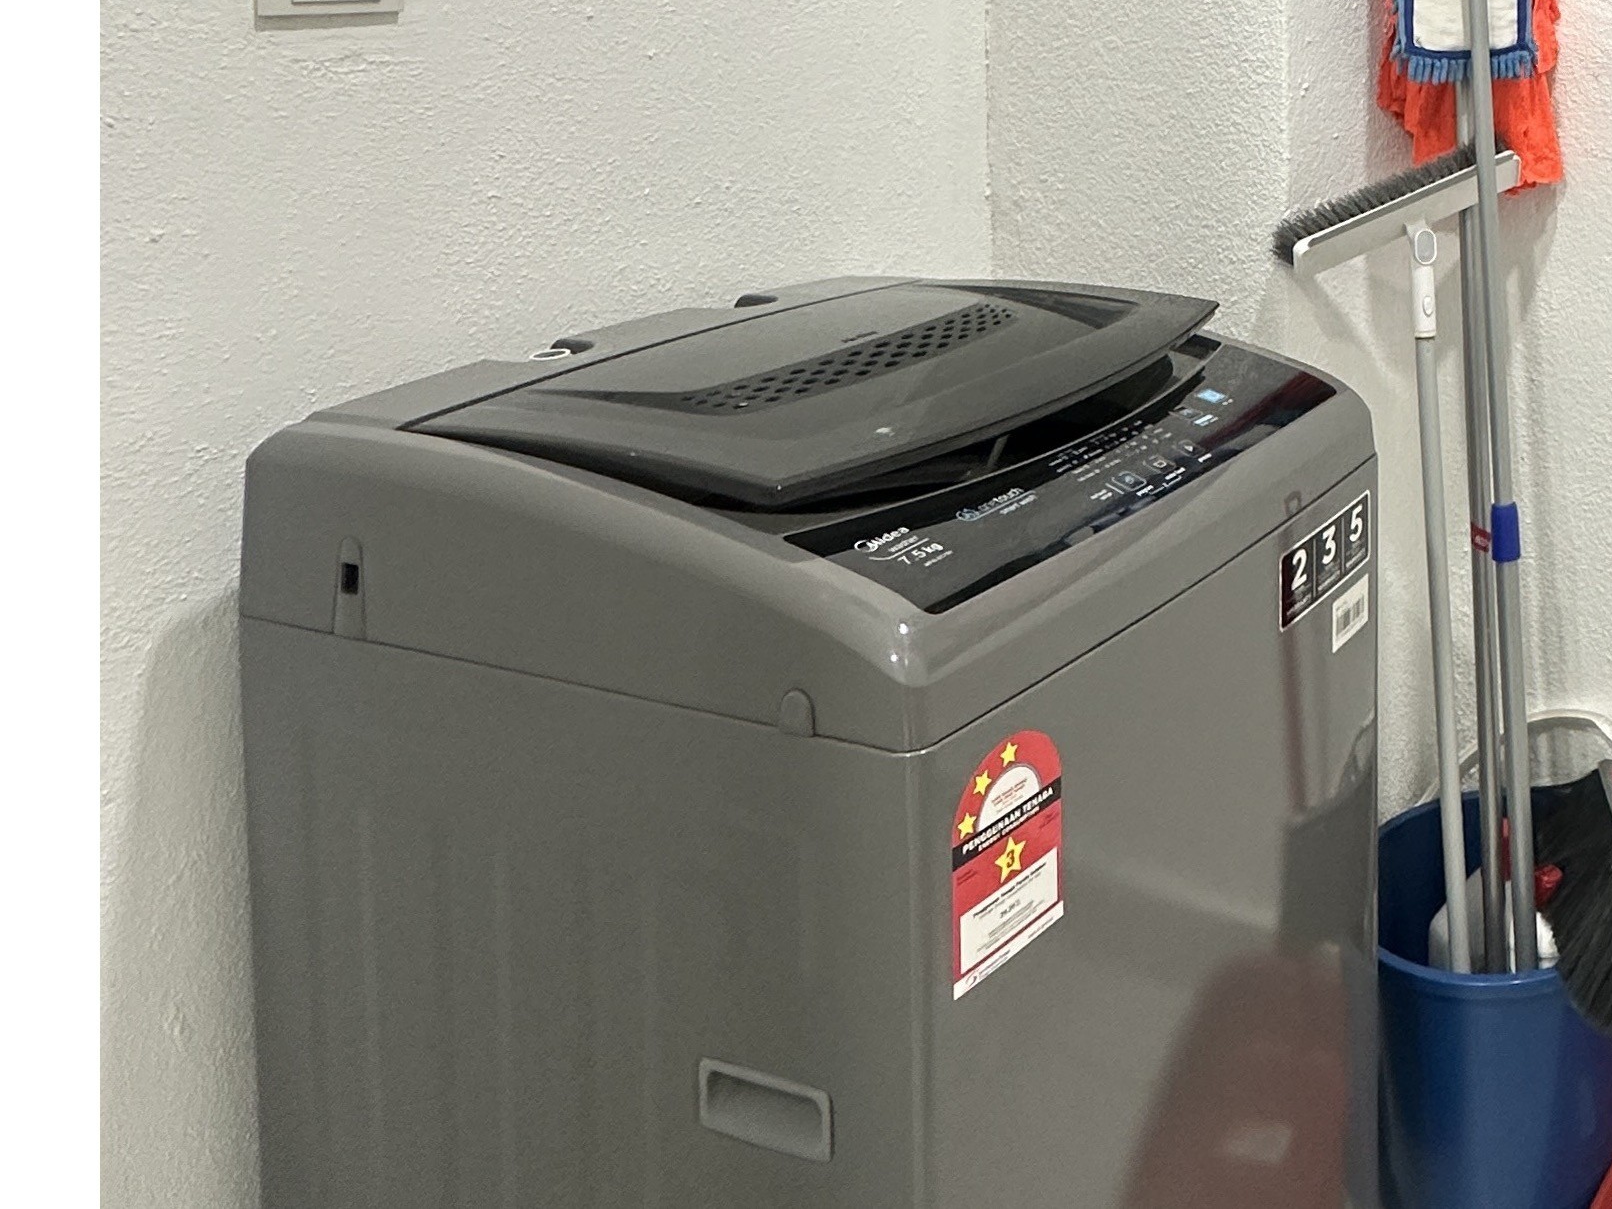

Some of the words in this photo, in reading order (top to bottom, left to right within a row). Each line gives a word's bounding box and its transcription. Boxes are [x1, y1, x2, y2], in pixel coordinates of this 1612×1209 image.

[854, 527, 910, 553] Midea
[1291, 548, 1308, 591] 2
[1321, 524, 1337, 565] 3
[1349, 503, 1363, 542] 5
[1006, 849, 1015, 869] 3
